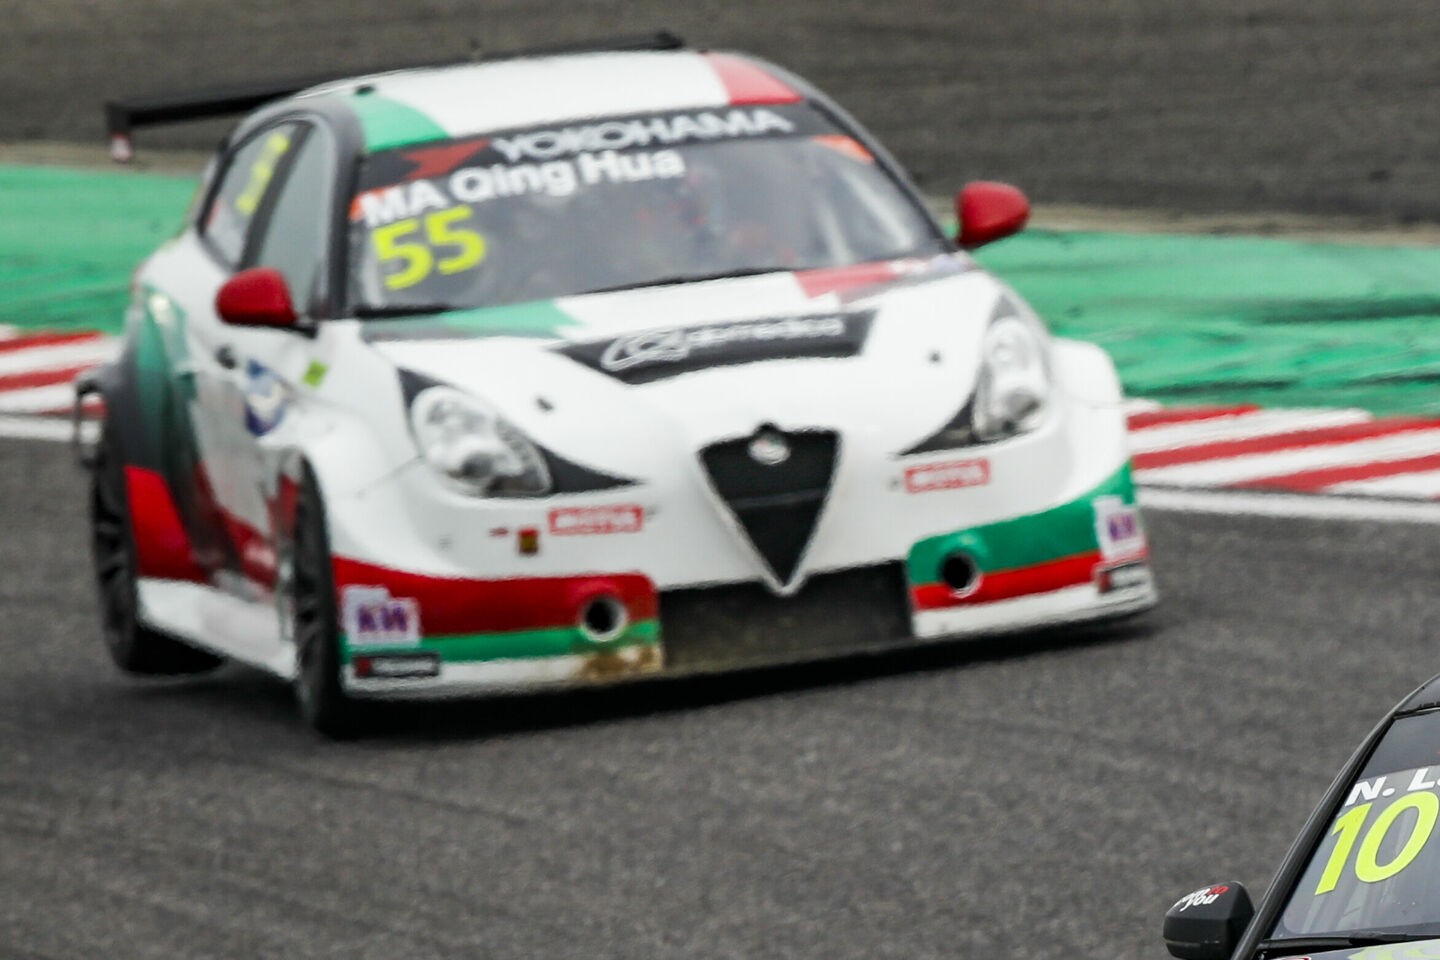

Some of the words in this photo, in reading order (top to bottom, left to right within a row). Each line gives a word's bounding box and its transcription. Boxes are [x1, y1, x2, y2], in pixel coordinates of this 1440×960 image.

[491, 106, 794, 163] YOKOHAMA
[360, 179, 448, 228] MA
[450, 157, 578, 203] Qing
[579, 147, 685, 184] Hua
[372, 204, 486, 291] 55
[1345, 776, 1396, 807] N.
[1315, 791, 1440, 896] 10
